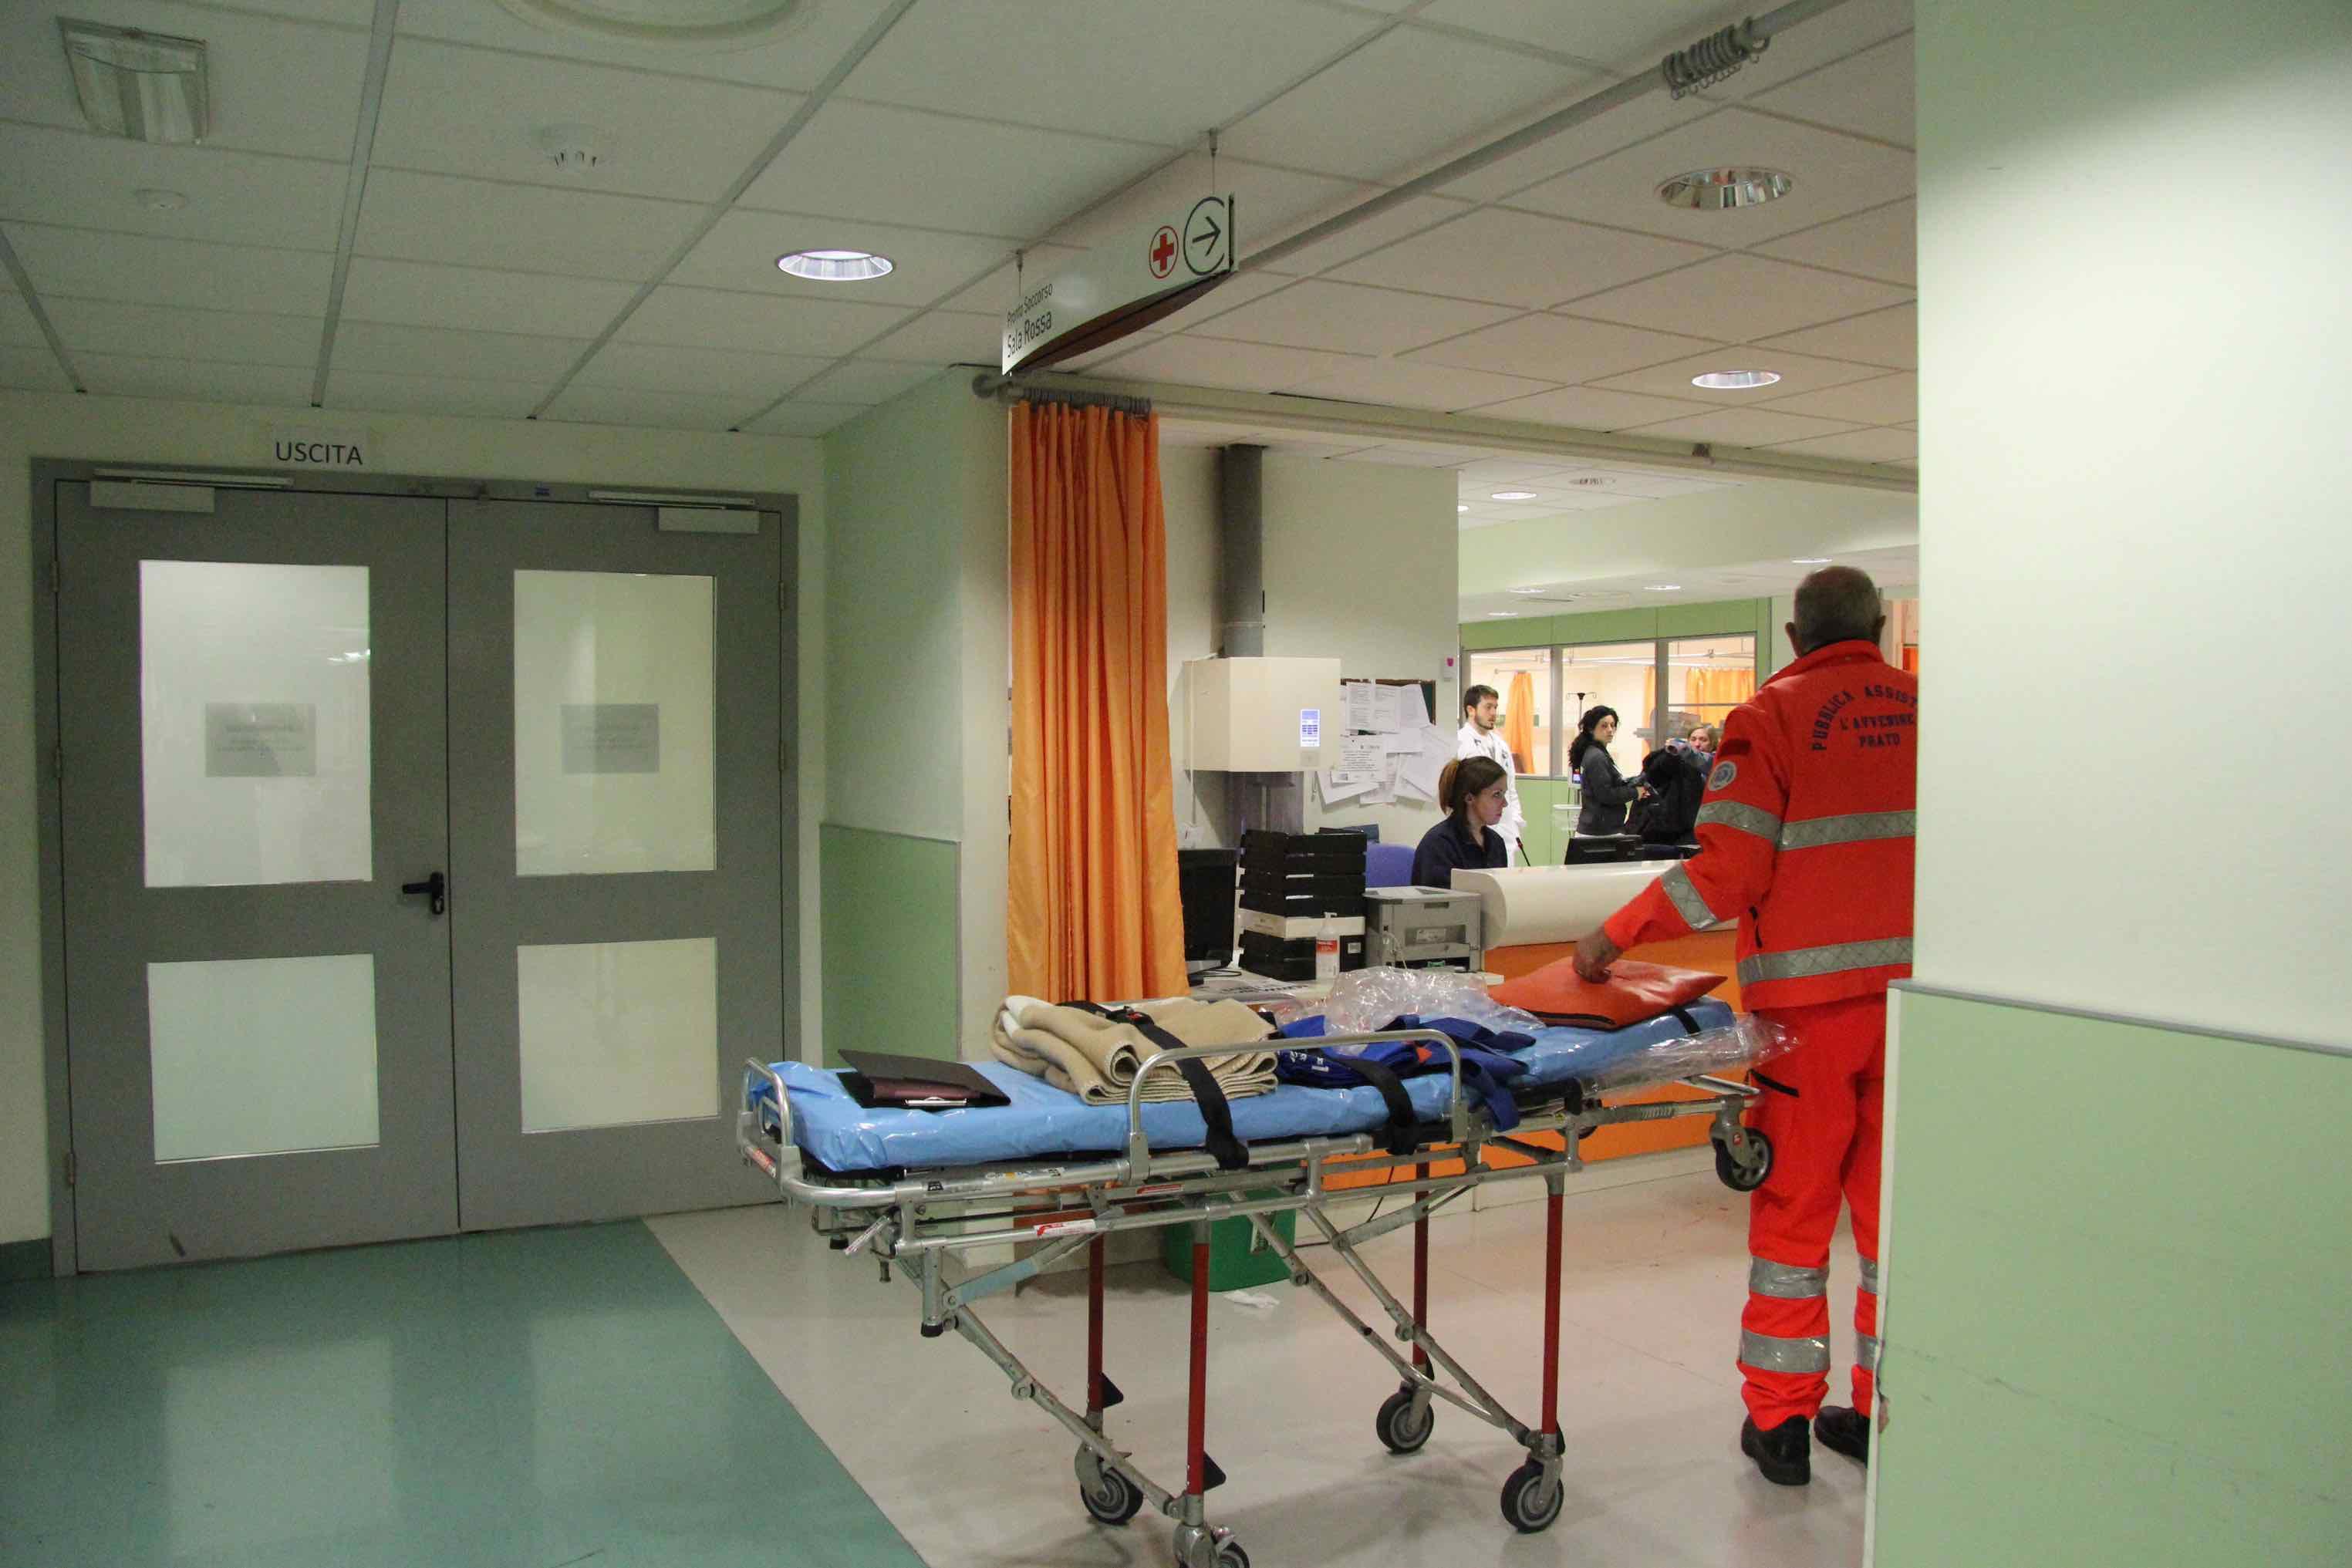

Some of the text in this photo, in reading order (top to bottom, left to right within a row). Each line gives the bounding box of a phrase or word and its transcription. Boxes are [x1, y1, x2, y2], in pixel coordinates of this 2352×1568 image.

[1024, 283, 1054, 314] Soccorso
[1007, 311, 1052, 358] Sala Rossa
[275, 441, 363, 465] USCITA
[1812, 689, 1855, 751] PUBBLICA
[1859, 731, 1902, 749] PRATO
